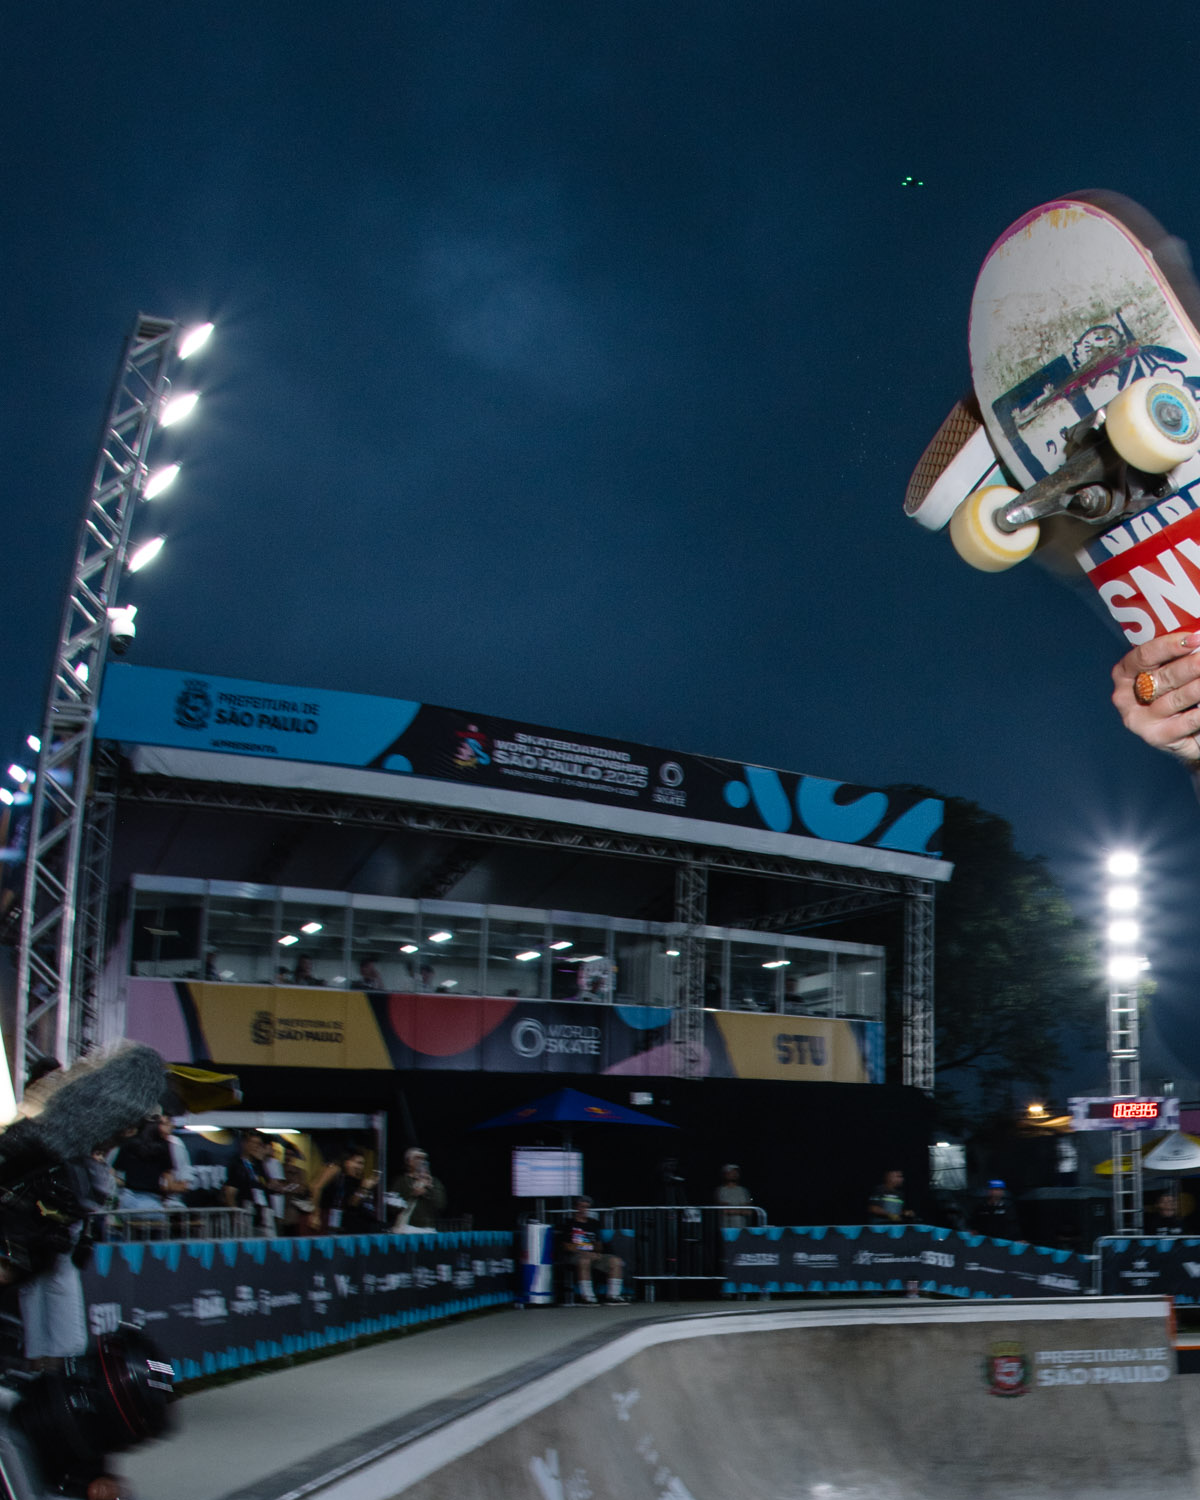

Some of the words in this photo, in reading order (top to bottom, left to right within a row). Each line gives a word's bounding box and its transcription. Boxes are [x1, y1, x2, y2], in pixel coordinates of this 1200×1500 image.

[217, 692, 299, 713] PREFEITURA
[302, 702, 320, 716] DE
[215, 707, 254, 728] SÃO
[257, 713, 318, 735] PAULO
[494, 740, 544, 757] WORLD
[546, 748, 648, 775] CHAMPIONSHIPS
[514, 732, 631, 762] SKATEBOARDING
[493, 750, 537, 769] SÃO
[538, 758, 602, 780] PAULO
[603, 770, 648, 788] 2025
[545, 1038, 600, 1055] SKATE
[774, 1033, 827, 1066] STU
[1035, 1349, 1140, 1364] PREFEITURA
[1142, 1347, 1168, 1361] DE
[1037, 1364, 1088, 1386] SÃO
[1090, 1365, 1170, 1385] PAULO
